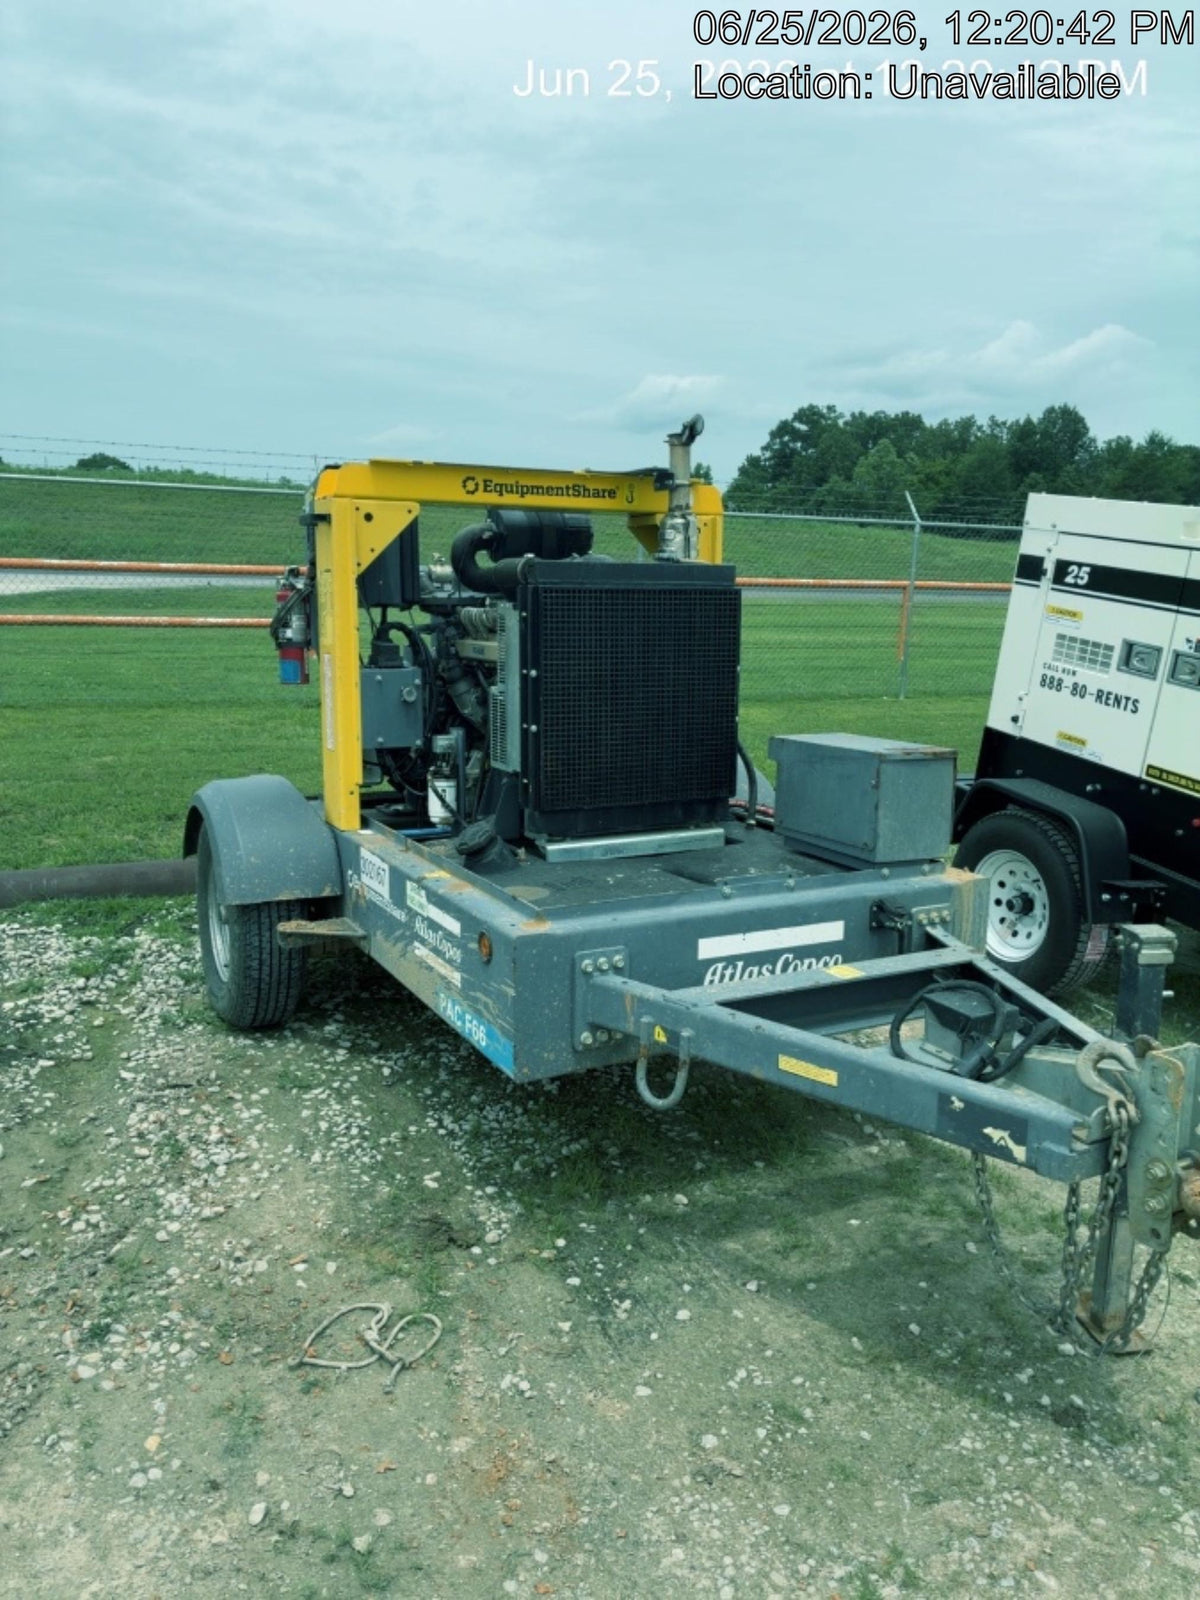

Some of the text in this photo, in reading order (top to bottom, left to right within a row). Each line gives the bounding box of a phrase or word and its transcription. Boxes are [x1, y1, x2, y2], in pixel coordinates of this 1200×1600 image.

[482, 479, 617, 500] EquipmentShare
[1064, 564, 1091, 586] 25
[1040, 673, 1140, 714] 888-80-RENTS
[465, 1012, 487, 1046] F66
